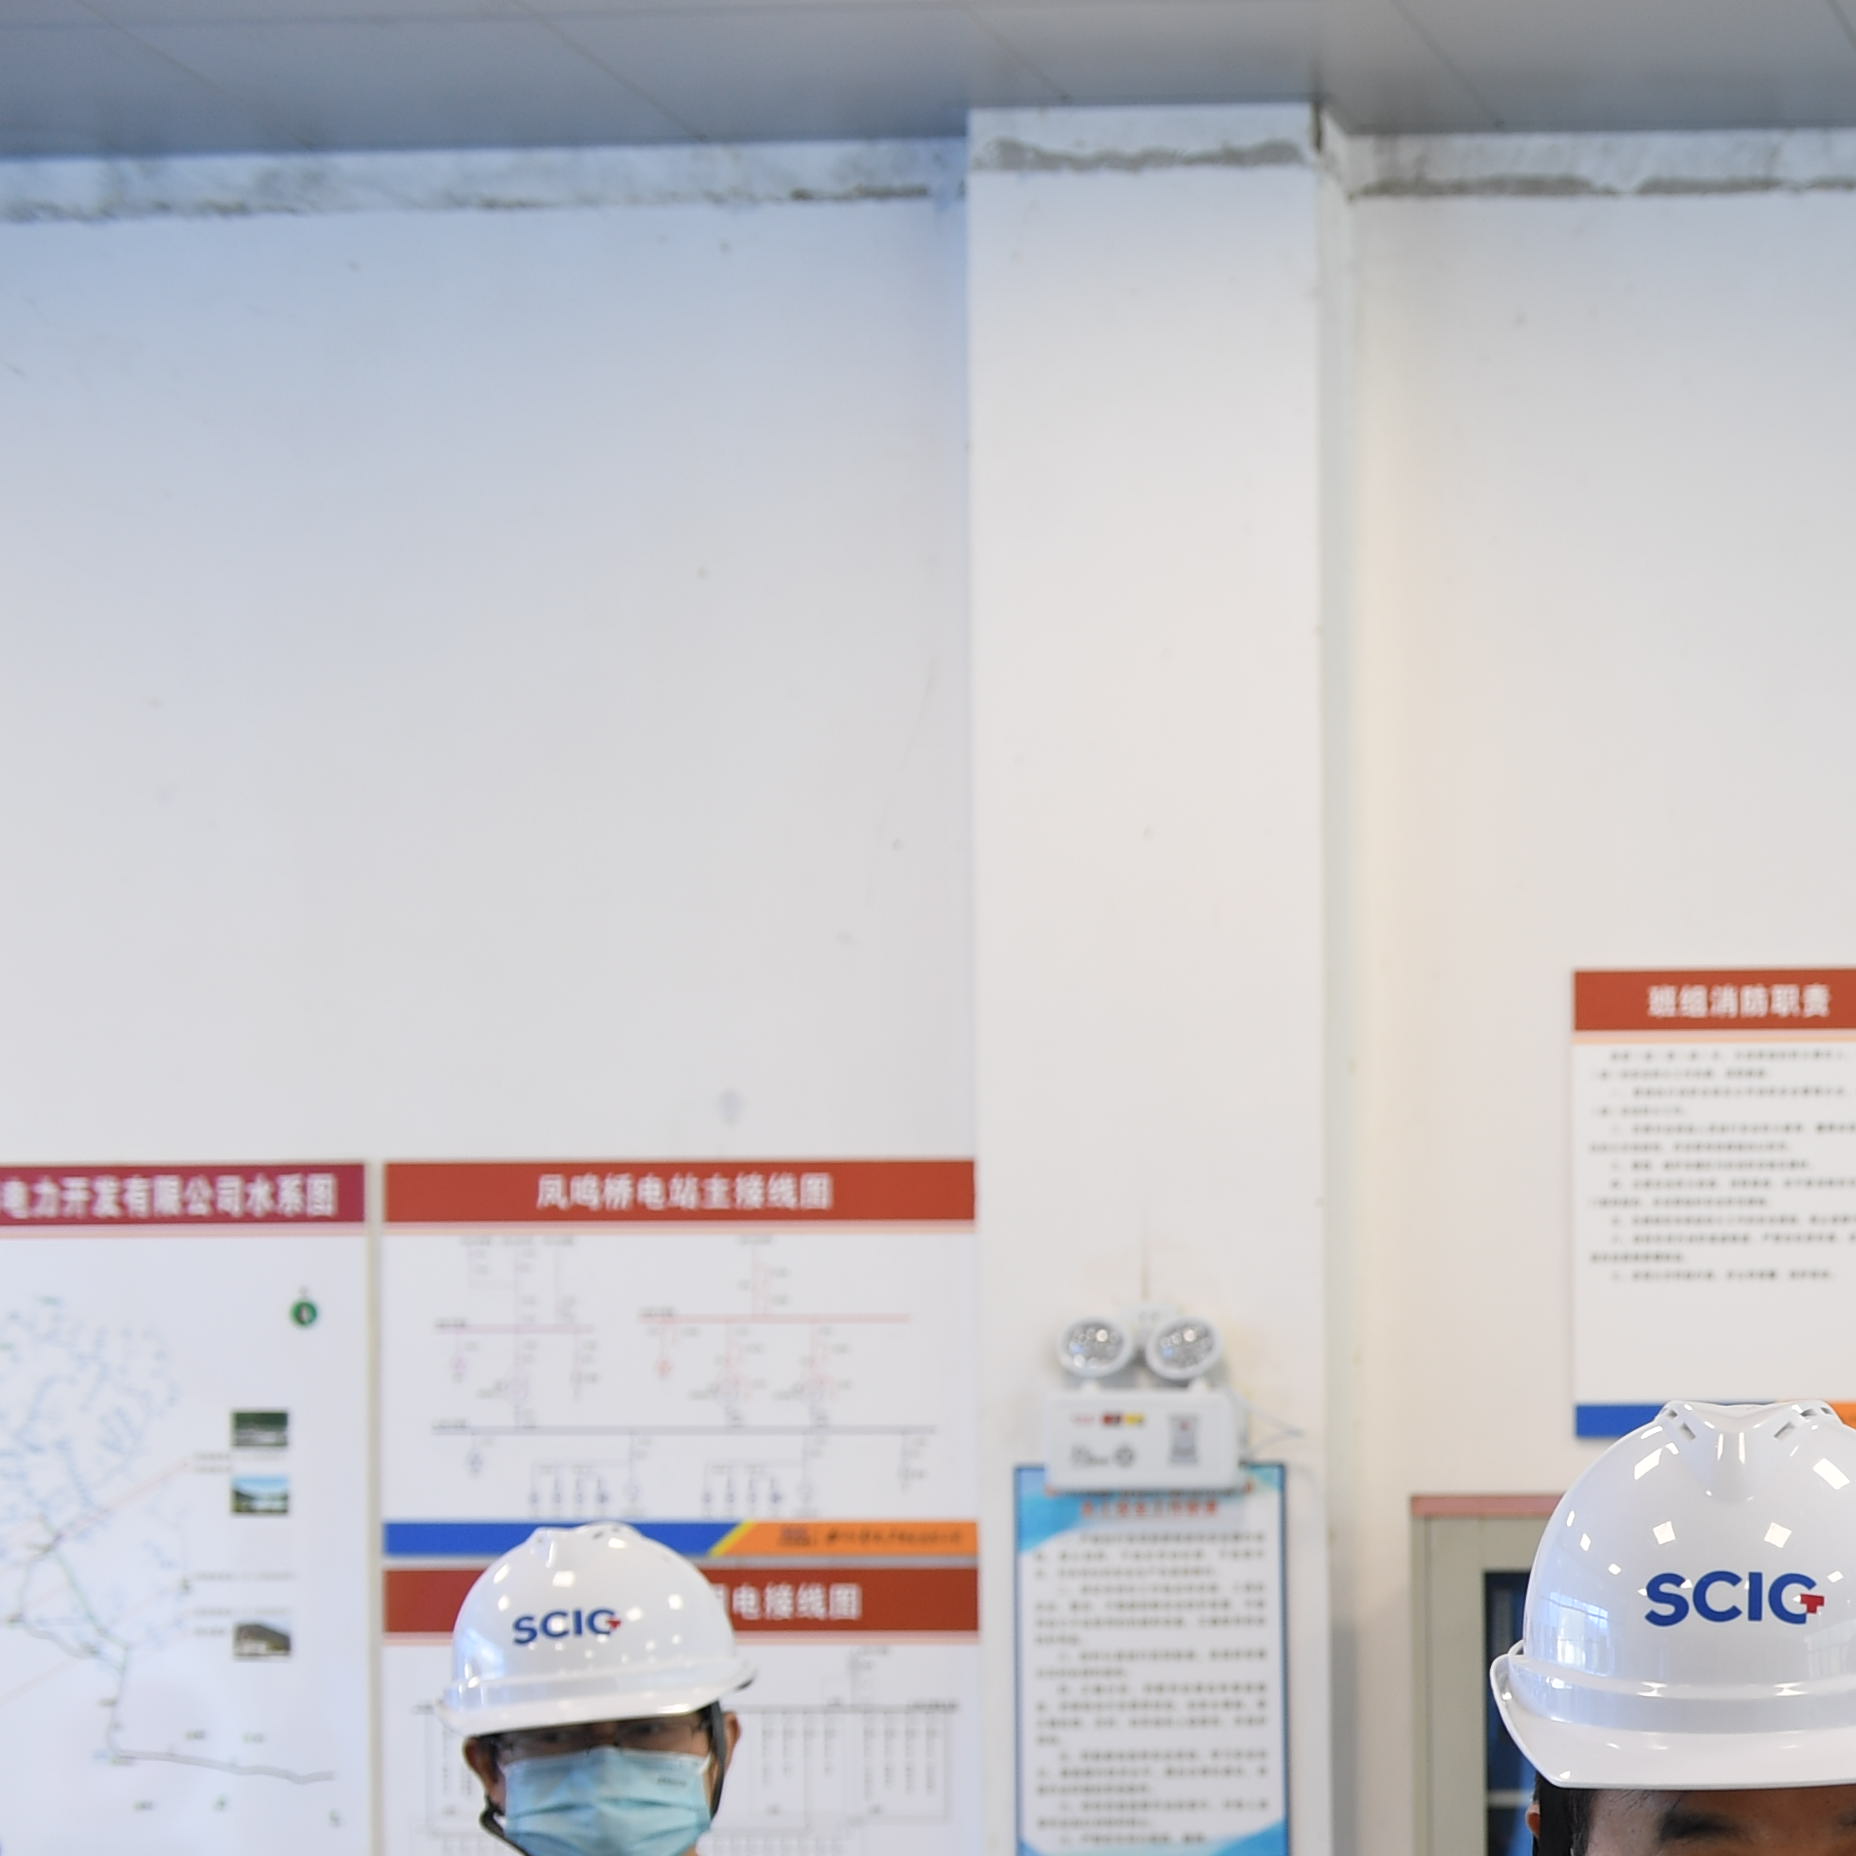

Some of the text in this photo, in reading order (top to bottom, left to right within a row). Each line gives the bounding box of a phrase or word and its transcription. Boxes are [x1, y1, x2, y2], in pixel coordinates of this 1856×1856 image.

[1646, 983, 1831, 1018] 班组消防职责
[1644, 1570, 1825, 1627] SCIG
[512, 1608, 621, 1645] SCIG
